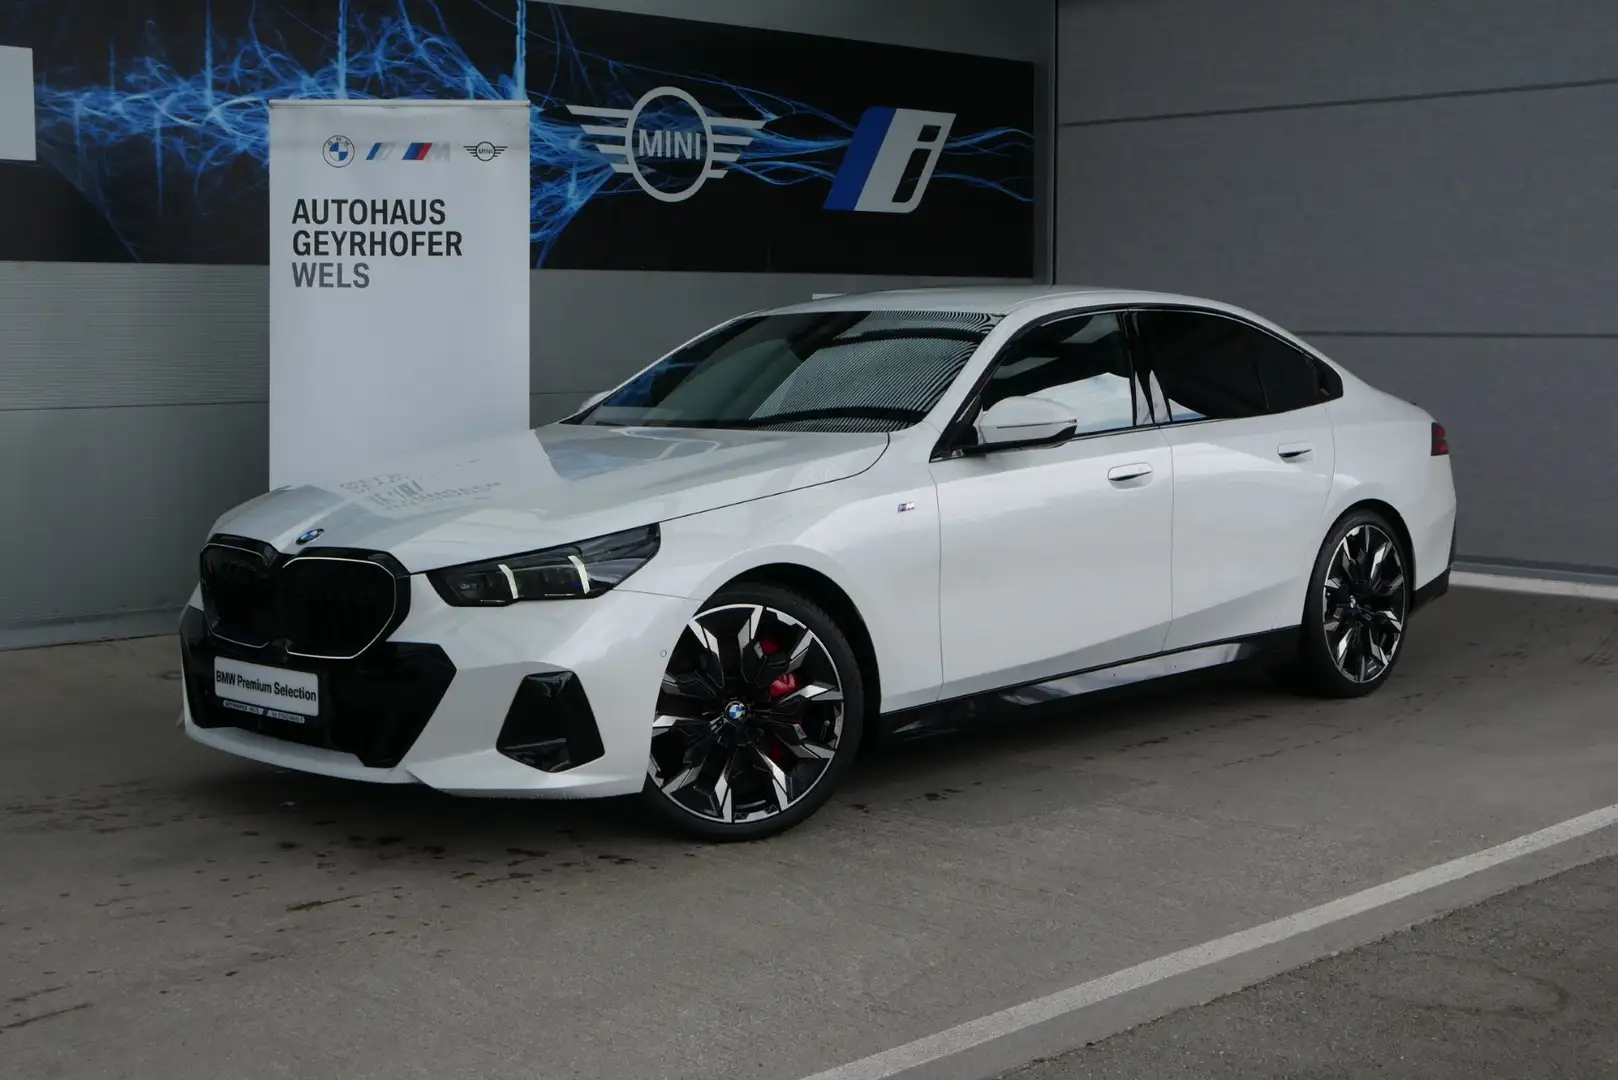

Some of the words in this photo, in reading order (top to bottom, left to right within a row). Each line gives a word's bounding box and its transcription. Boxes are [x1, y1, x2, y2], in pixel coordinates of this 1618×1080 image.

[638, 128, 701, 160] MINI
[291, 198, 446, 225] AUTOHAUS
[292, 230, 463, 257] GEYRHOFER
[291, 262, 370, 289] WELS
[215, 669, 236, 687] BMW
[237, 674, 272, 695] Premium
[273, 681, 317, 702] Selection
